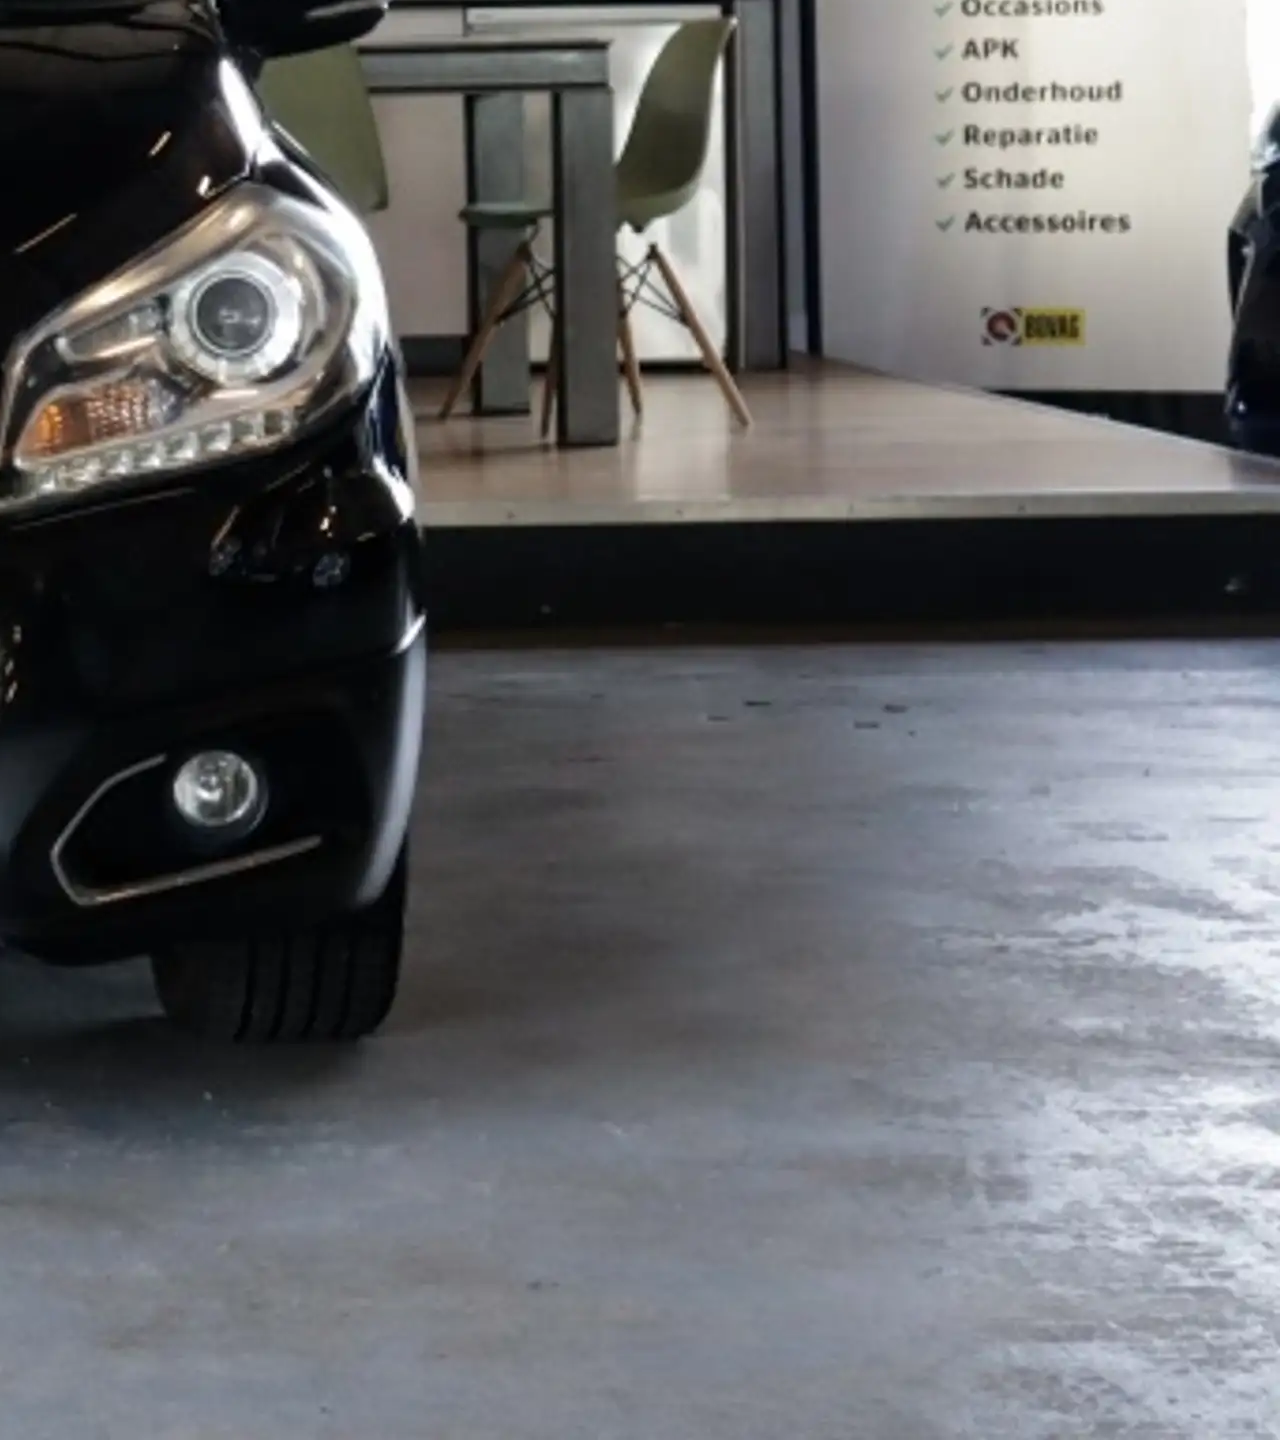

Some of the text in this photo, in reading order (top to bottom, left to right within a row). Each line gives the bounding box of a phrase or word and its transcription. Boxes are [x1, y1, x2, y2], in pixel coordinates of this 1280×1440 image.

[961, 37, 1019, 59] APK
[961, 79, 1123, 103] Onderhoud
[963, 123, 1098, 149] Reparatie
[963, 166, 1064, 189] Schade
[964, 210, 1131, 233] Accessoires
